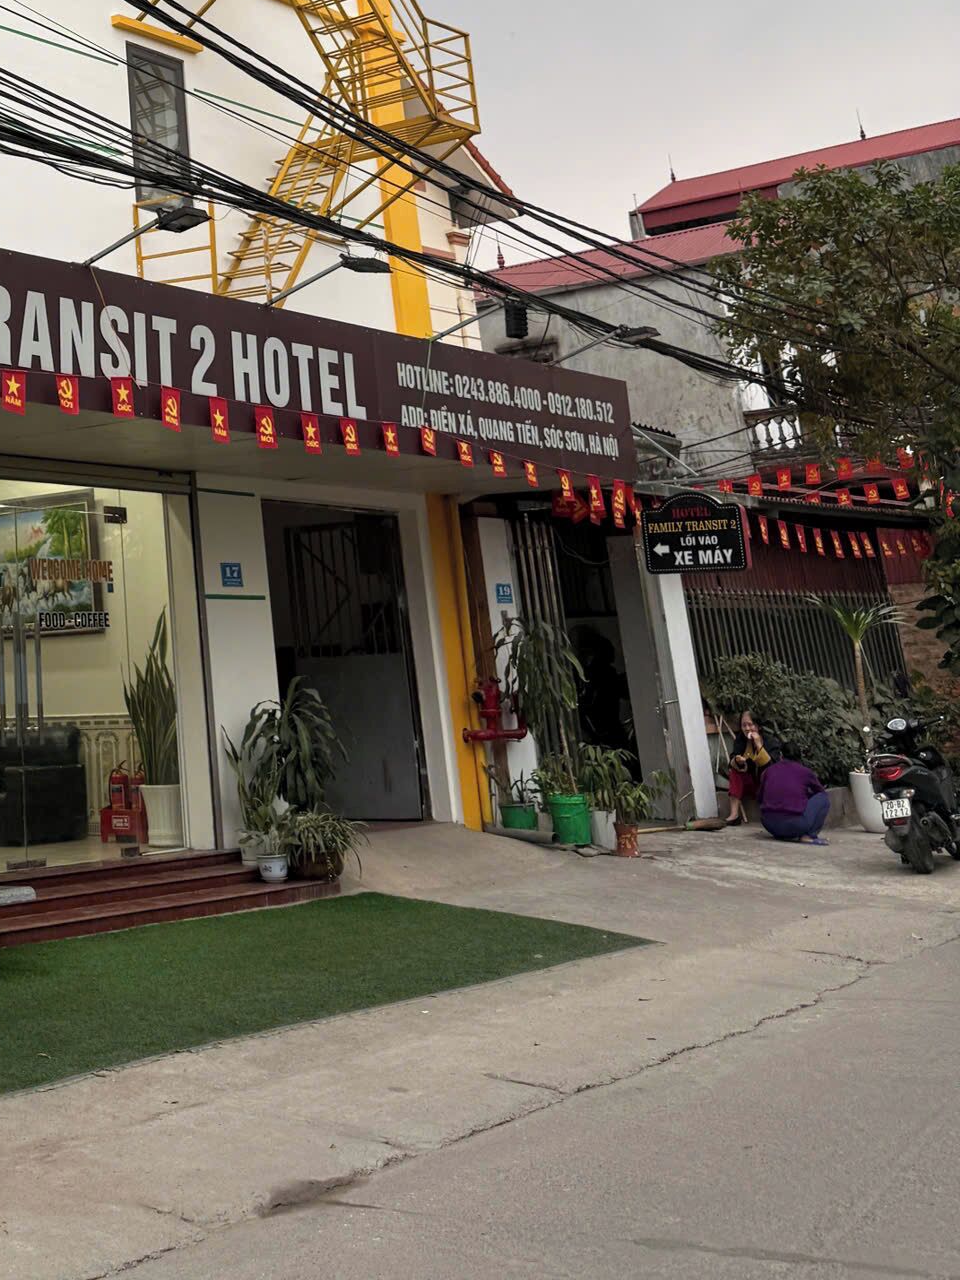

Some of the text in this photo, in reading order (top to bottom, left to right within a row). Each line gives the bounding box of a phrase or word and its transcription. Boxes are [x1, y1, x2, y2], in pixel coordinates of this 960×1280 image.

[189, 324, 218, 396] 2
[231, 332, 367, 420] HOTEL
[478, 417, 515, 442] QUANG
[543, 424, 565, 449] SÓC
[602, 433, 620, 461] NỘI
[672, 506, 711, 518] HOTEL
[648, 520, 737, 534] FAMILY TRANSIT 2
[680, 533, 696, 546] LỐI
[673, 546, 733, 566] XE MÁY
[31, 558, 113, 582] WELCOME HOME
[225, 566, 239, 577] 17
[499, 585, 511, 596] 19
[39, 612, 65, 628] FOOD
[74, 612, 110, 628] COFFEE
